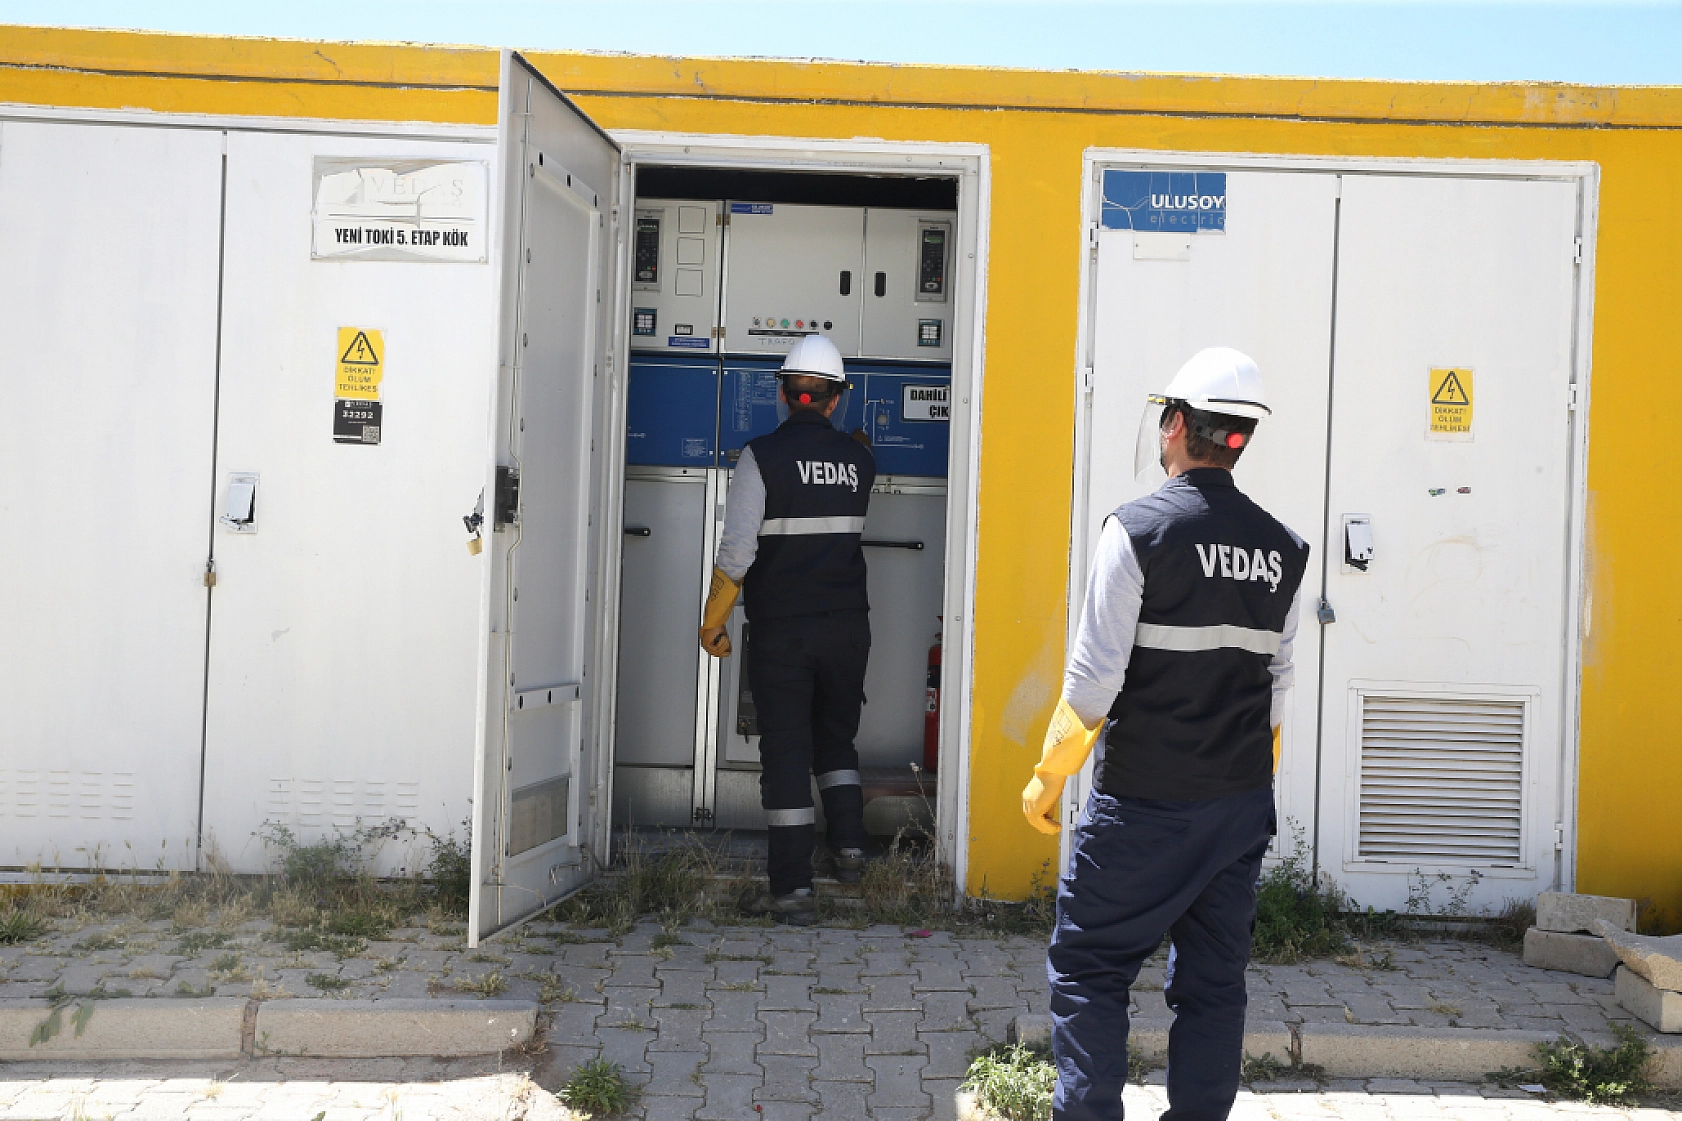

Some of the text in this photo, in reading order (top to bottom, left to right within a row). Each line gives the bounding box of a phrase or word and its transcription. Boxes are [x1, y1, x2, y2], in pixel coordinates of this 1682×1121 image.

[1151, 194, 1224, 209] ULUSOY
[1150, 213, 1223, 225] electric
[335, 227, 469, 247] YENİ TOKİ 5. ETAP KÖK
[757, 337, 796, 346] TRAFO
[796, 460, 859, 493] VEDAŞ
[1194, 543, 1282, 593] VEDAŞ
